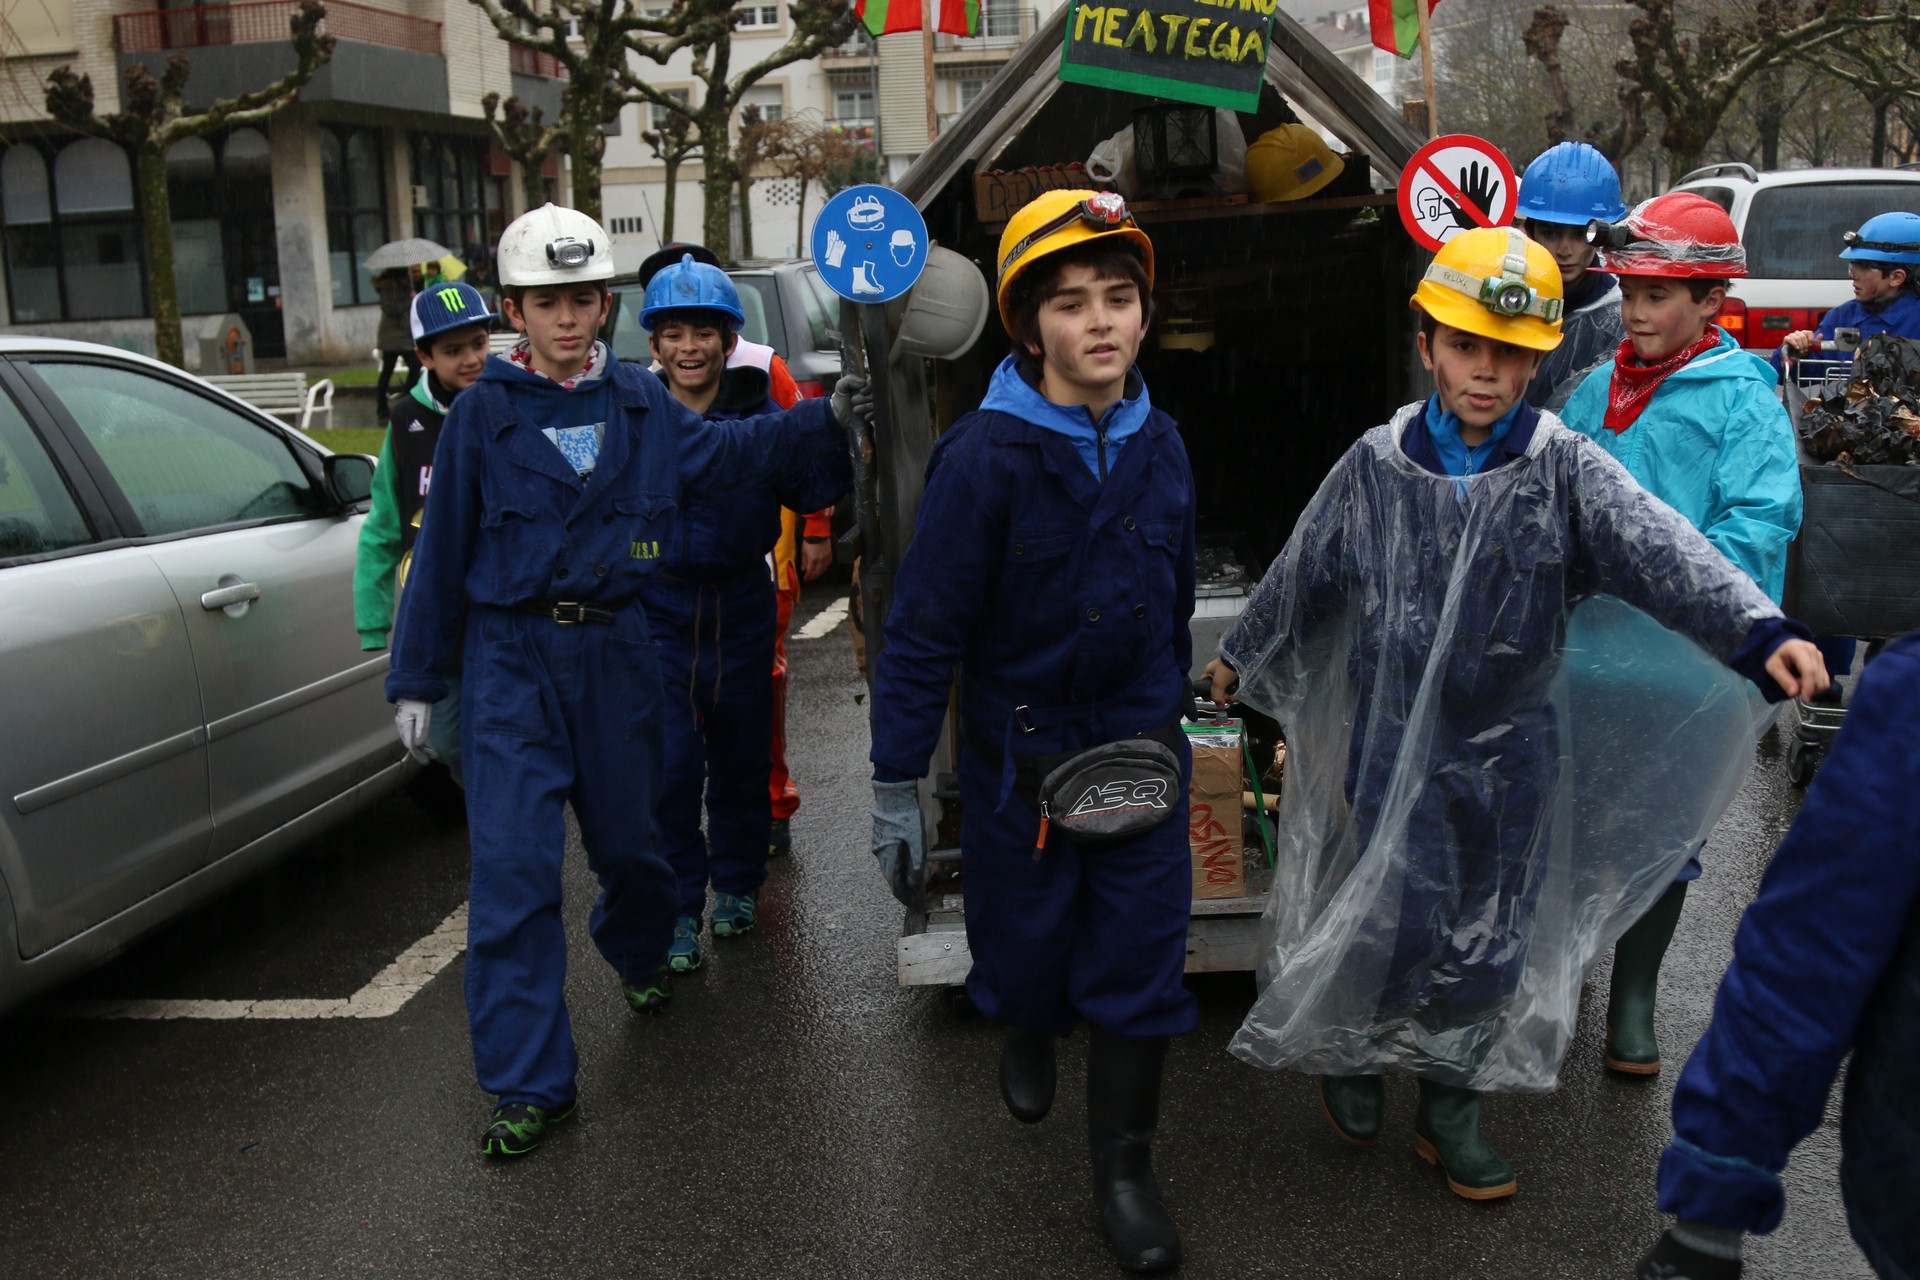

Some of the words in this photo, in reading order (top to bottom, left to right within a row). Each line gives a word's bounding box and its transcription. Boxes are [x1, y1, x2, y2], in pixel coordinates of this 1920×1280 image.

[1075, 4, 1265, 62] MEATEGIA
[1065, 778, 1168, 817] ABQ
[1190, 788, 1237, 885] OSIVO
